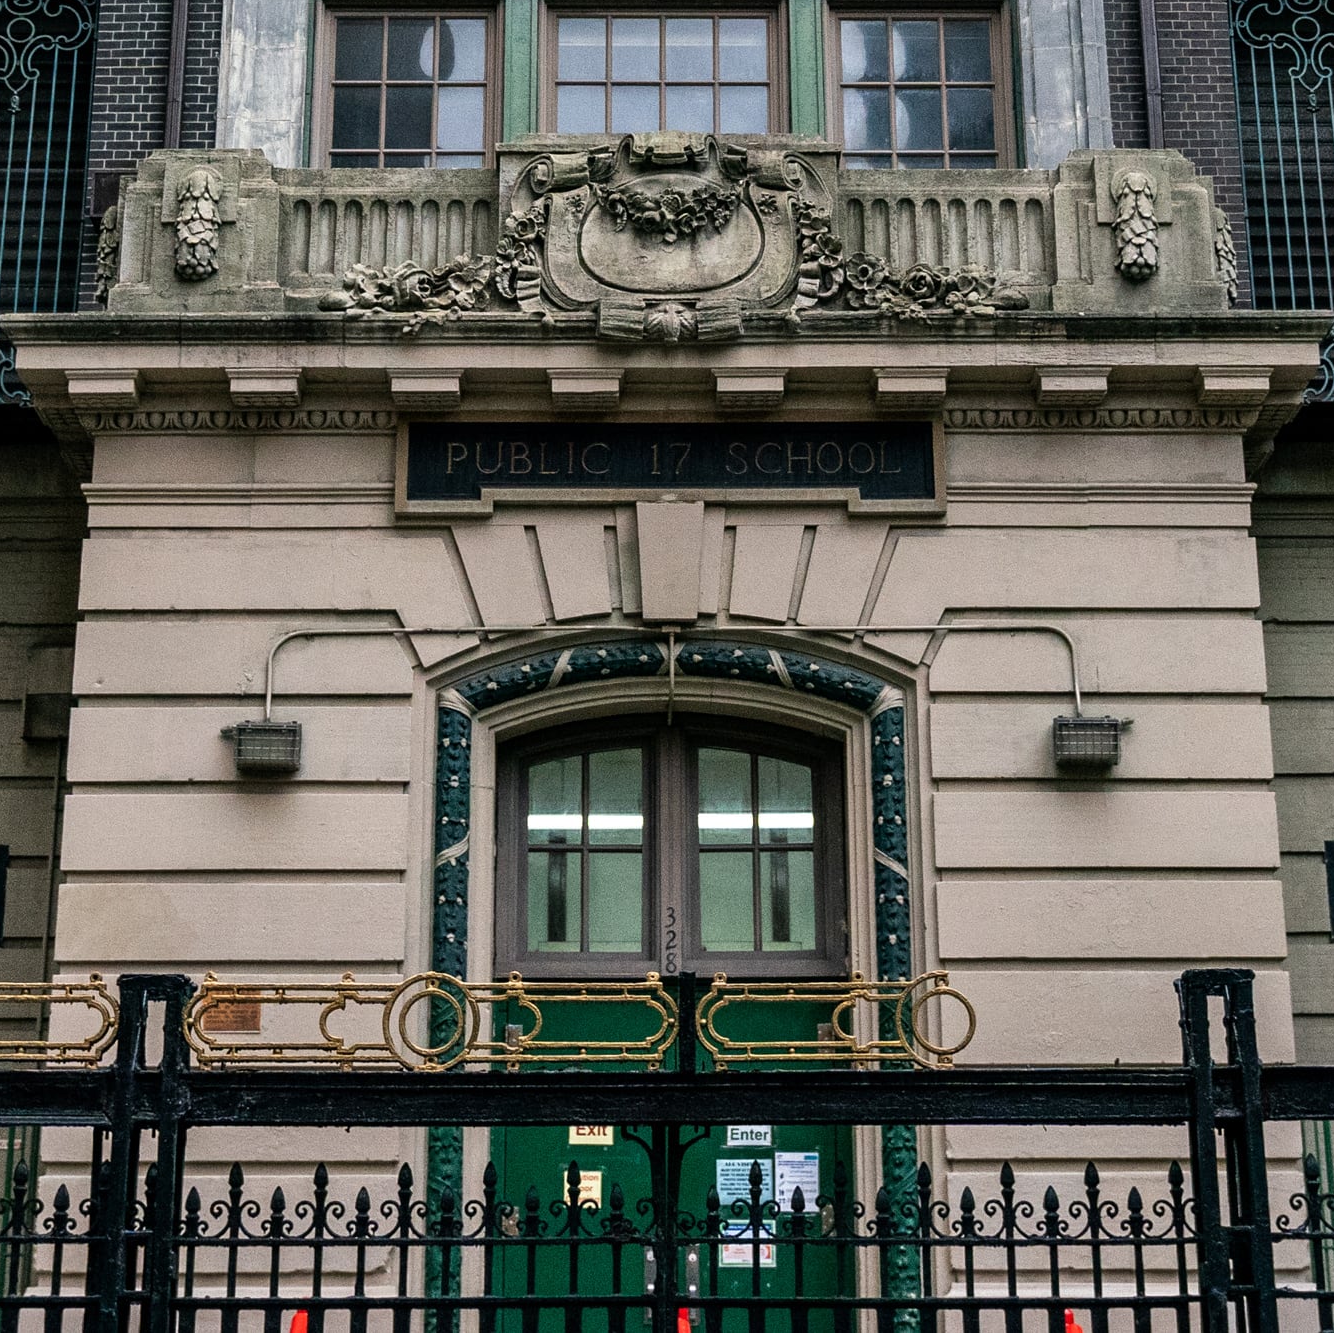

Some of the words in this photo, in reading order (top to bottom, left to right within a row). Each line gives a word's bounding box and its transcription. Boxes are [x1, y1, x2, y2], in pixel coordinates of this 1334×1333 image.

[445, 441, 612, 474] PUBLIC
[650, 441, 692, 474] 17
[725, 441, 902, 474] SCHOOL
[665, 906, 678, 974] 328
[576, 1125, 608, 1136] Exit
[730, 1128, 769, 1141] Enter
